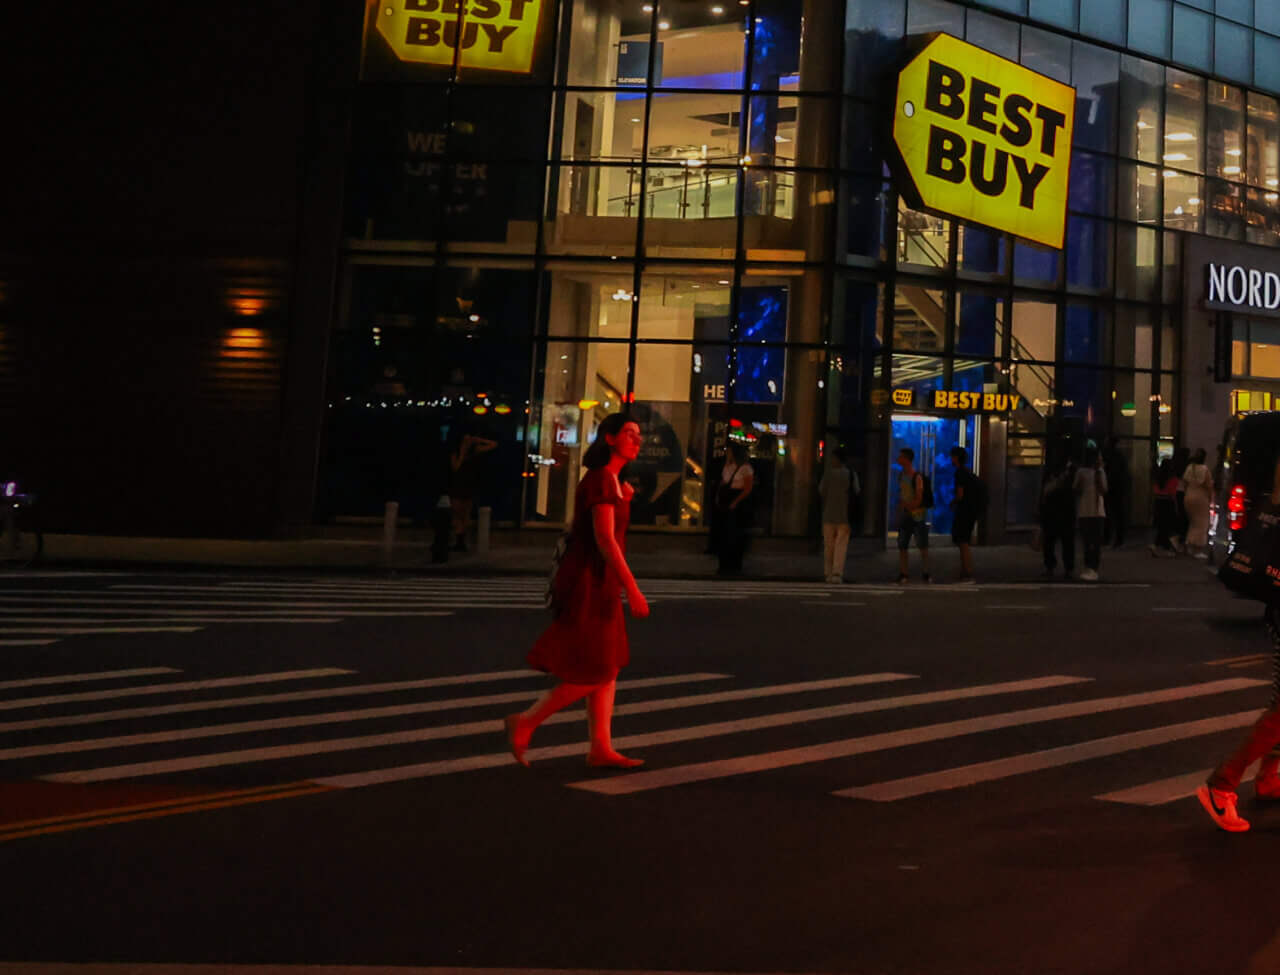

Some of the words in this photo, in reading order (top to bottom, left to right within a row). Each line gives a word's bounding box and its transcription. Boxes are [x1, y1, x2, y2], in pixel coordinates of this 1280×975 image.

[405, 16, 518, 53] BUY
[924, 59, 1066, 158] BEST
[925, 125, 1050, 211] BUY
[934, 390, 981, 410] BEST
[983, 393, 1020, 412] BUY
